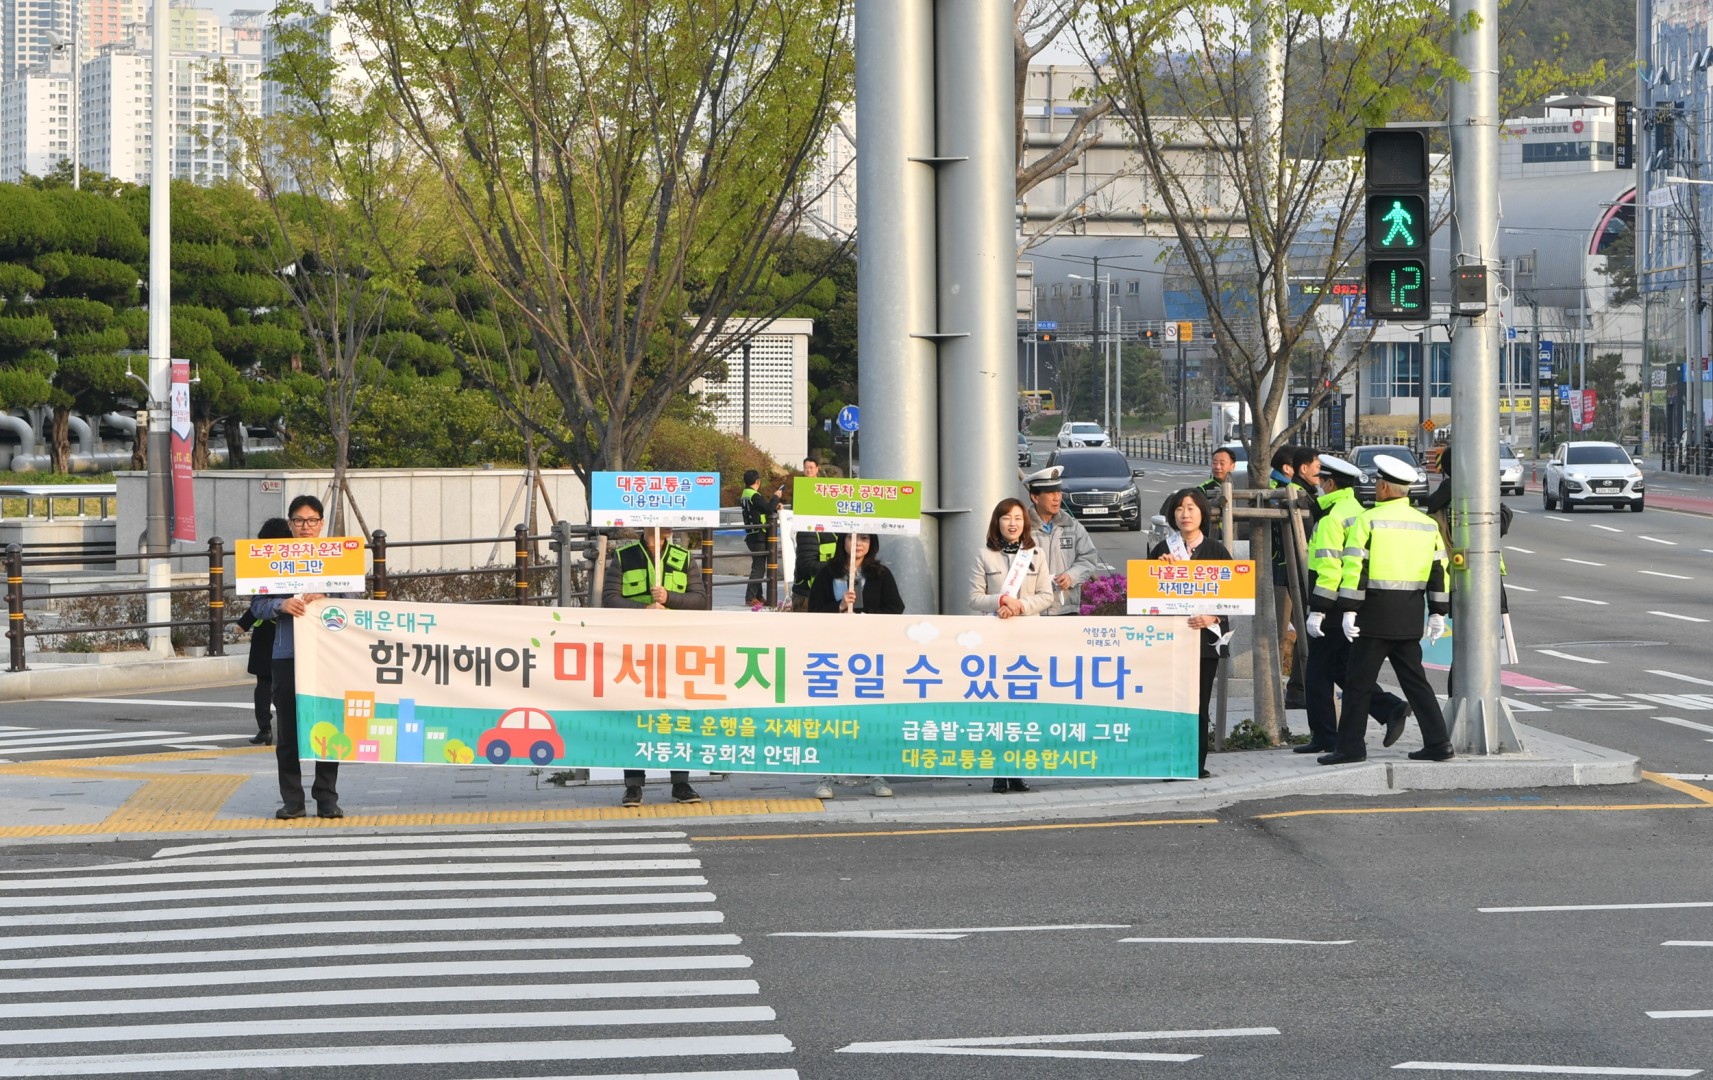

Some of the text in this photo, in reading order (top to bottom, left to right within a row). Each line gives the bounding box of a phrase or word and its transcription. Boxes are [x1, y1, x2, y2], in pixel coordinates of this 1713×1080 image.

[1390, 266, 1421, 308] 12
[617, 476, 692, 493] 대중교통을
[815, 484, 898, 500] 자동차 공회전
[622, 494, 687, 508] 이용합니다
[836, 500, 875, 514] 안돼요
[250, 542, 342, 559] 노후 경유차 운전
[270, 560, 323, 574] 이제 그만
[1149, 565, 1232, 581] 나홀로 운행을
[1158, 582, 1219, 595] 자제합니다
[353, 609, 437, 634] 해운대구
[1083, 627, 1117, 637] 사람중심
[1119, 624, 1174, 647] 해운대
[1086, 638, 1121, 648] 미래도시
[369, 638, 1144, 704] 함께해야 미세먼지 줄일 수 있습니다.
[636, 713, 860, 740] 나홀로 운행을 자제합시다
[902, 720, 1131, 743] 급출발·급제동은 이제 그만
[635, 742, 820, 766] 자동차 공회전 안돼요
[902, 748, 1098, 770] 대중교통을 이용합시다
